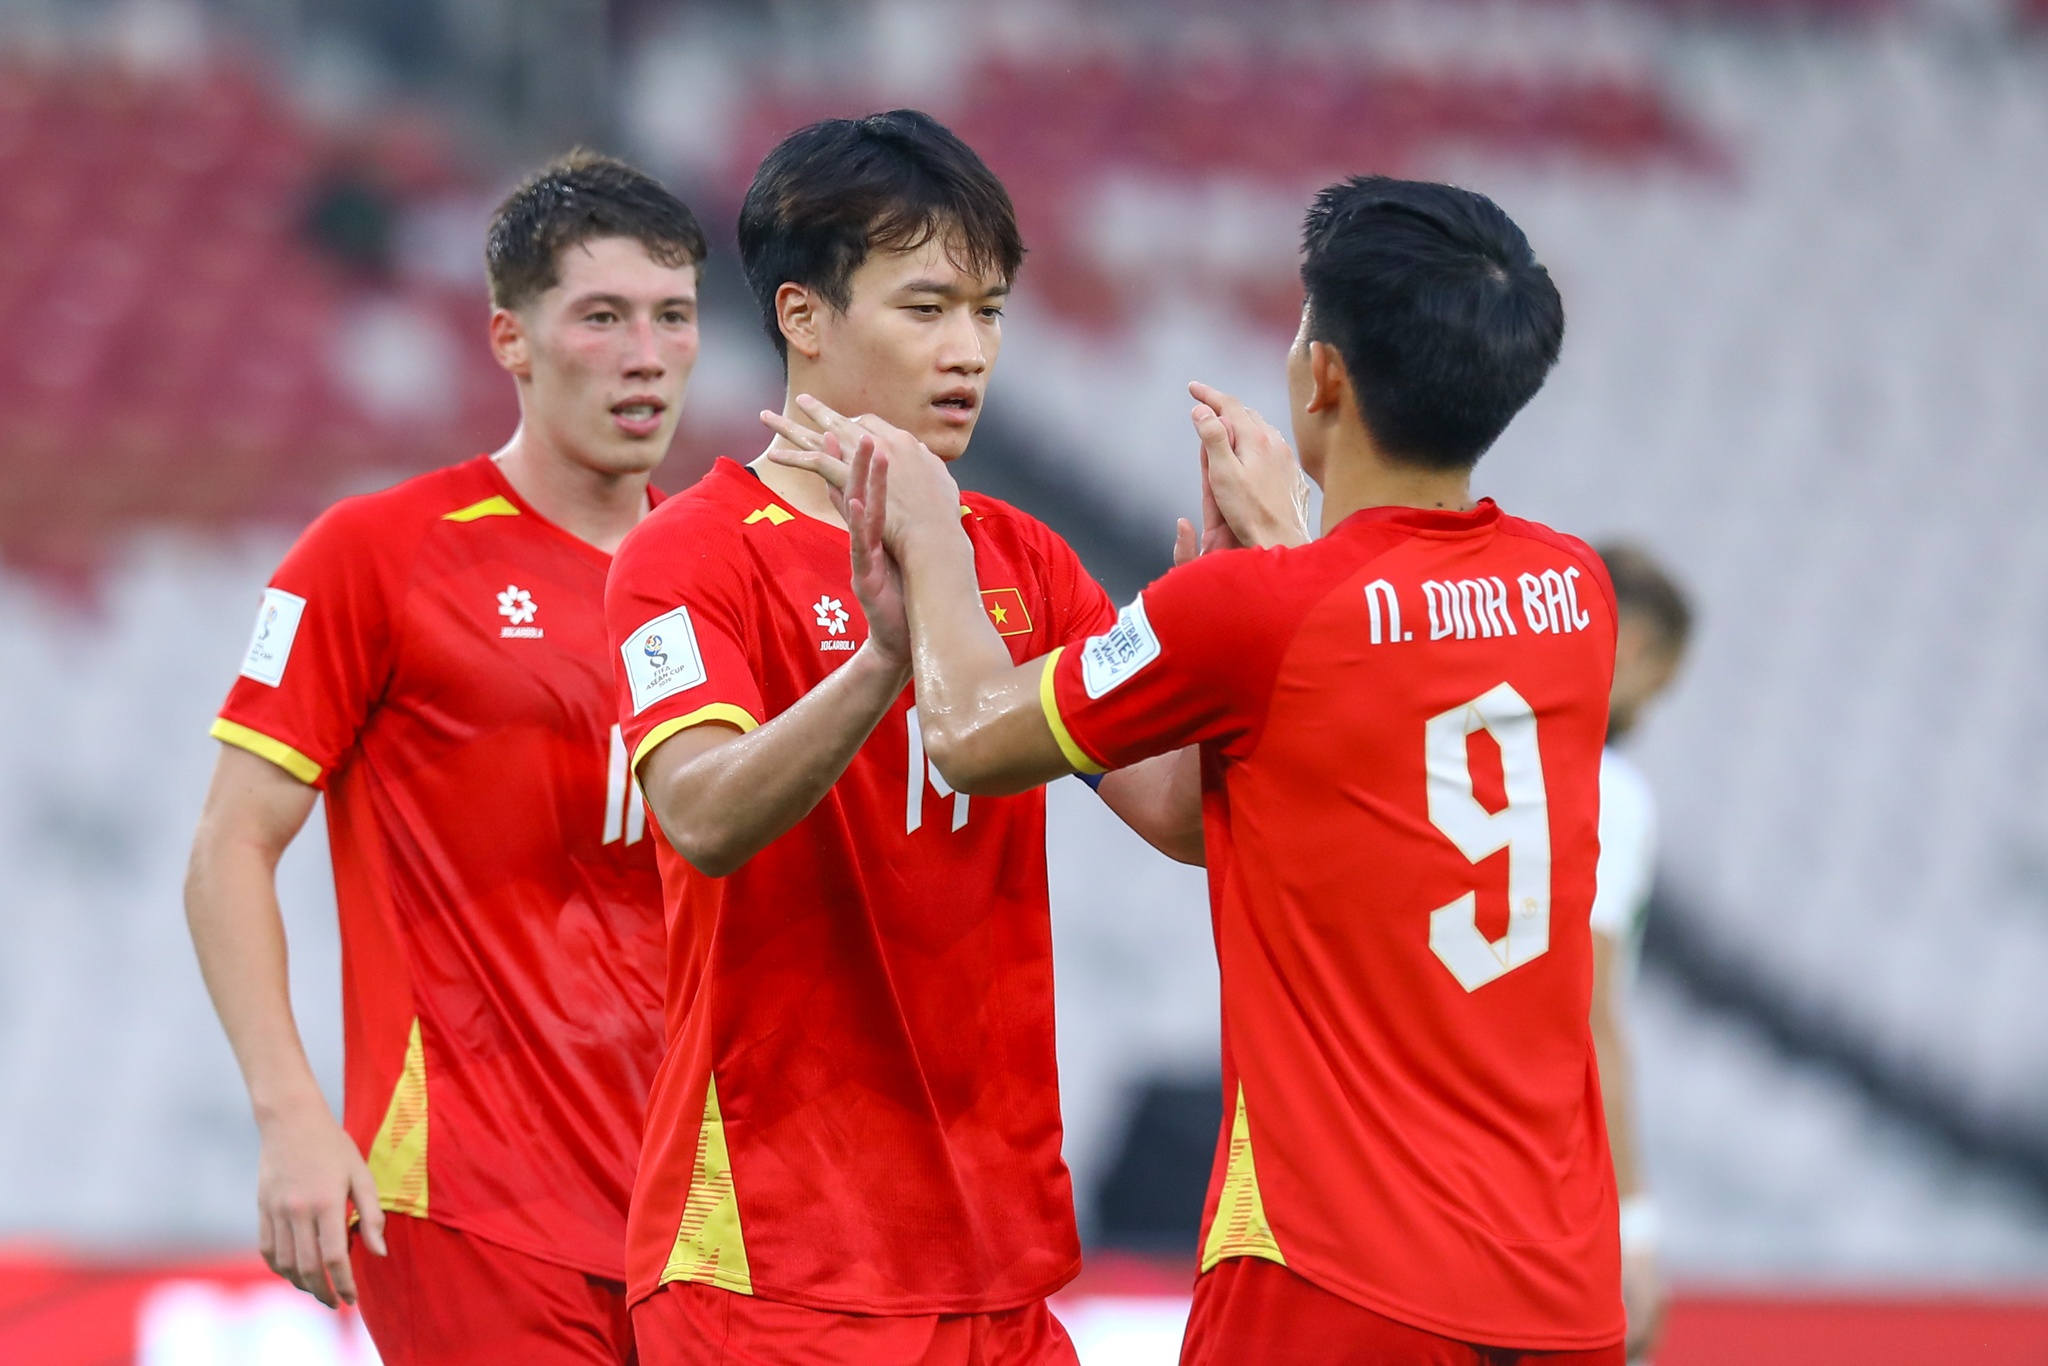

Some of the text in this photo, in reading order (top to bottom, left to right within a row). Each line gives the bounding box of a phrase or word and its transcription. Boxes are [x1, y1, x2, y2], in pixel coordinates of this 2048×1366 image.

[1421, 576, 1518, 641] DINH
[1517, 565, 1590, 635] BAC
[1109, 628, 1135, 664] ITES
[646, 665, 685, 690] ASEAN CUP
[654, 665, 671, 677] FIFA
[1425, 680, 1552, 993] 9
